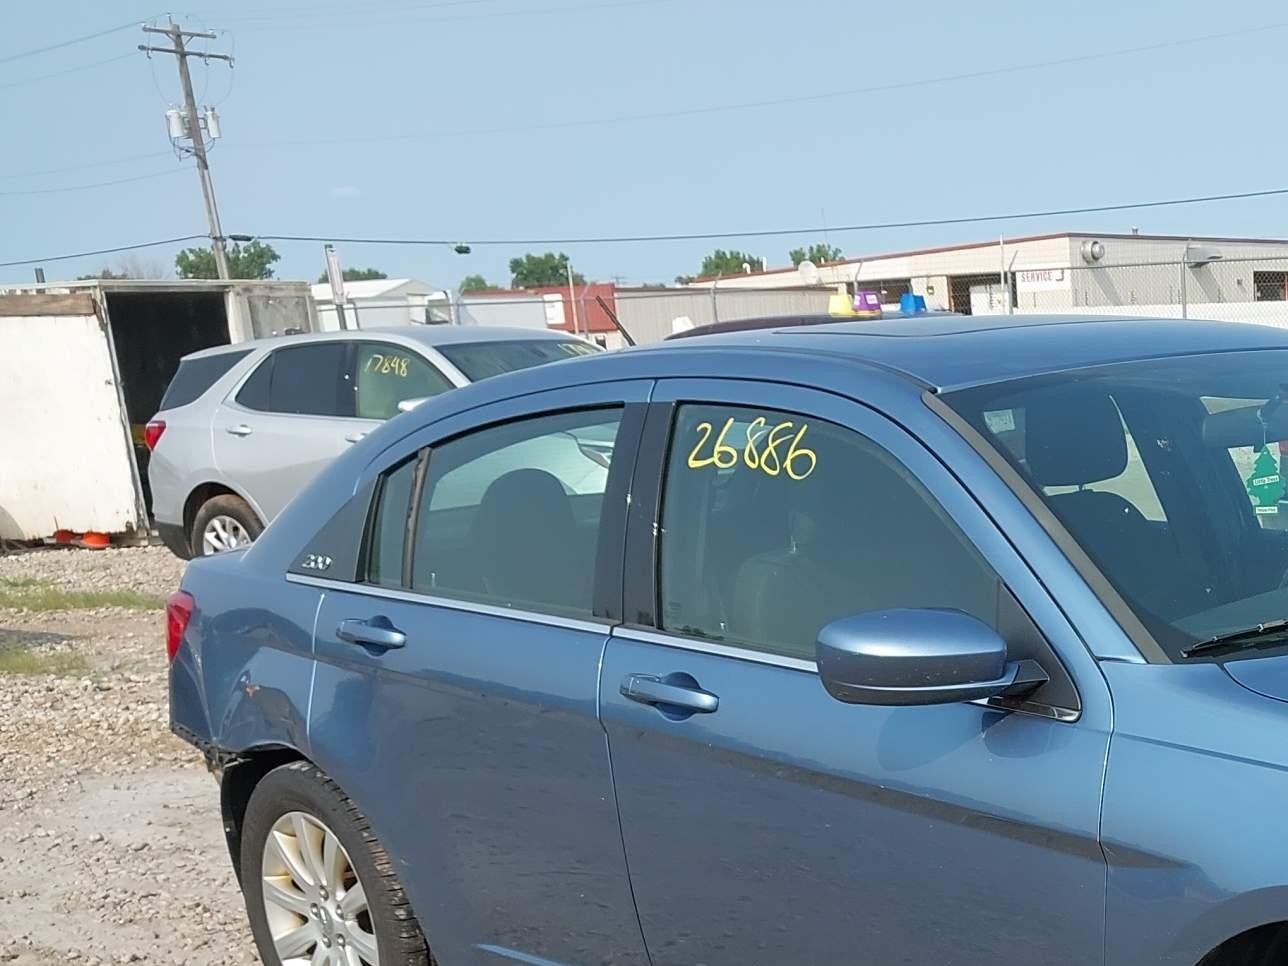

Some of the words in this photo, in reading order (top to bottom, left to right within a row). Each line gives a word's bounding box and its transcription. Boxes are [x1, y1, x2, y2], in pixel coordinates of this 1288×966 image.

[1021, 271, 1053, 282] SERVICE
[364, 353, 410, 378] 17848
[688, 416, 817, 480] 26886
